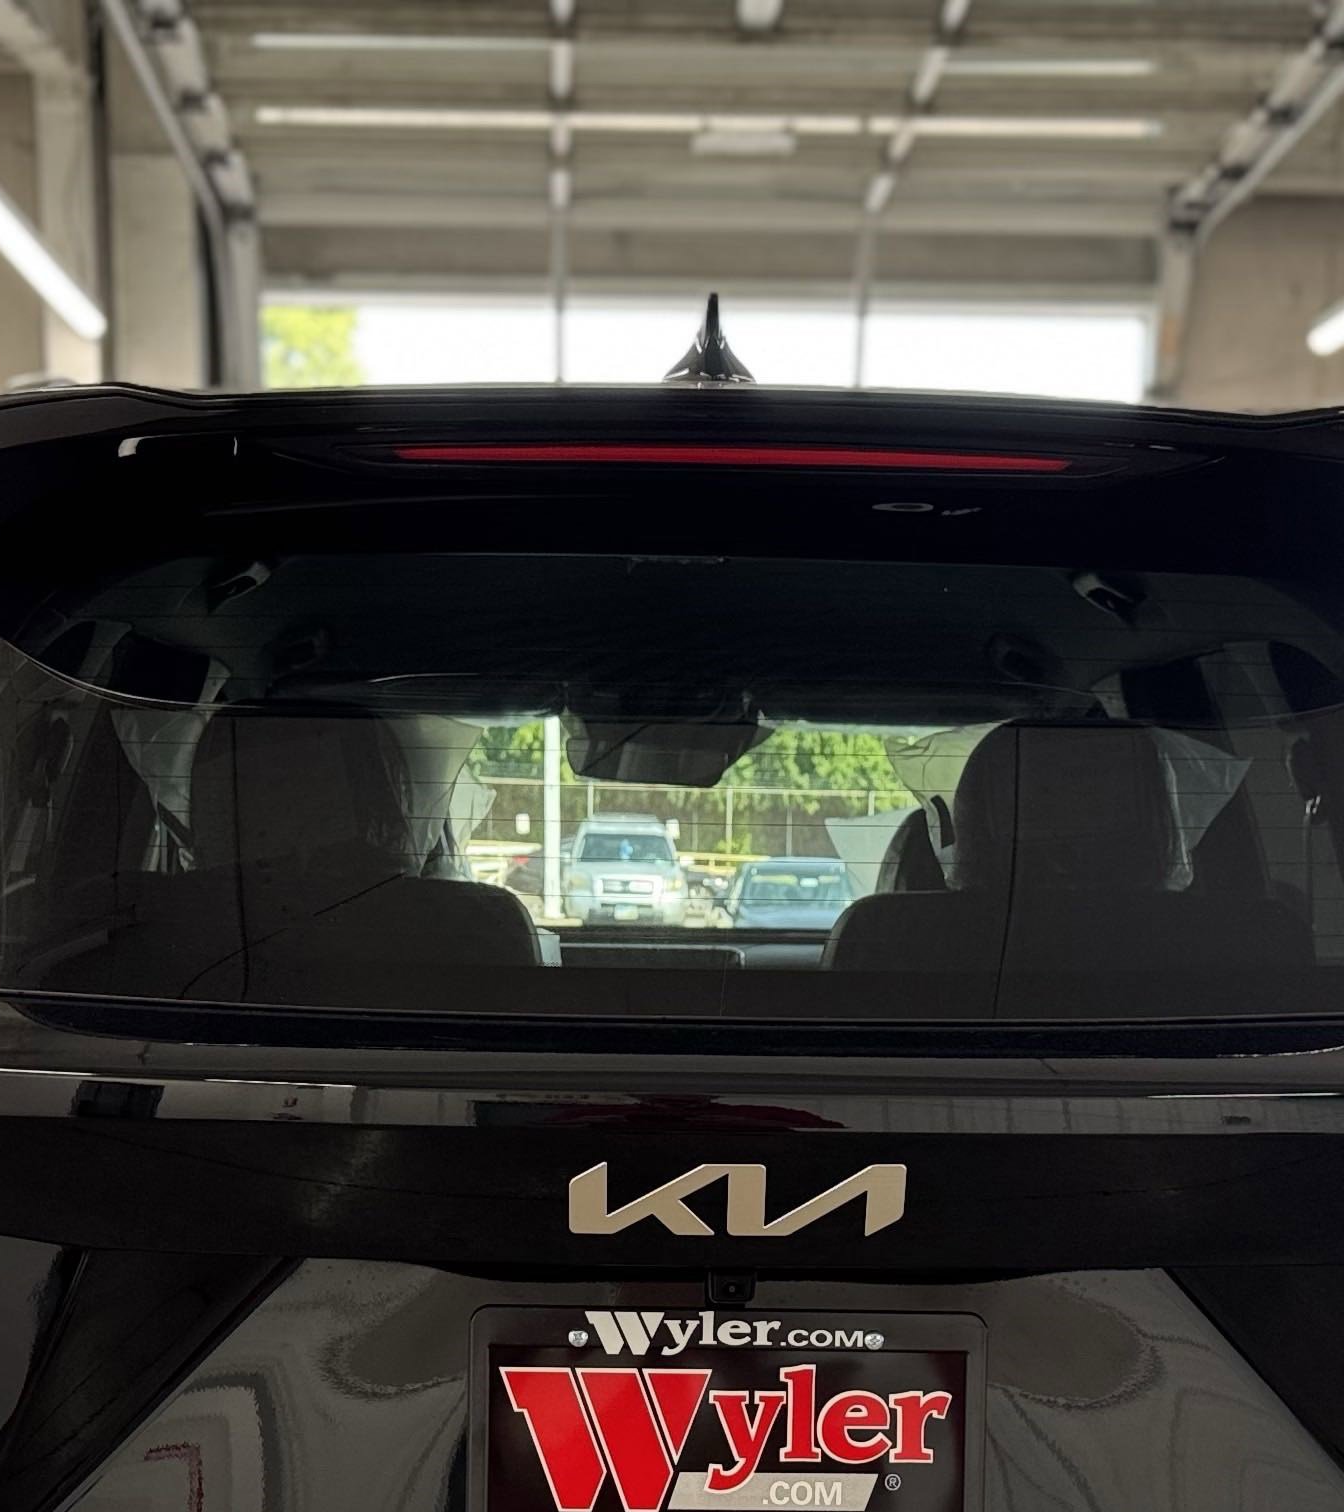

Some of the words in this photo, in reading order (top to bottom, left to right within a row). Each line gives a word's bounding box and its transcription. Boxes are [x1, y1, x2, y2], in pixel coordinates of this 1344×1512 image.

[568, 1161, 907, 1236] KIA
[498, 1364, 953, 1512] Wyler
[762, 1480, 843, 1506] .COM
